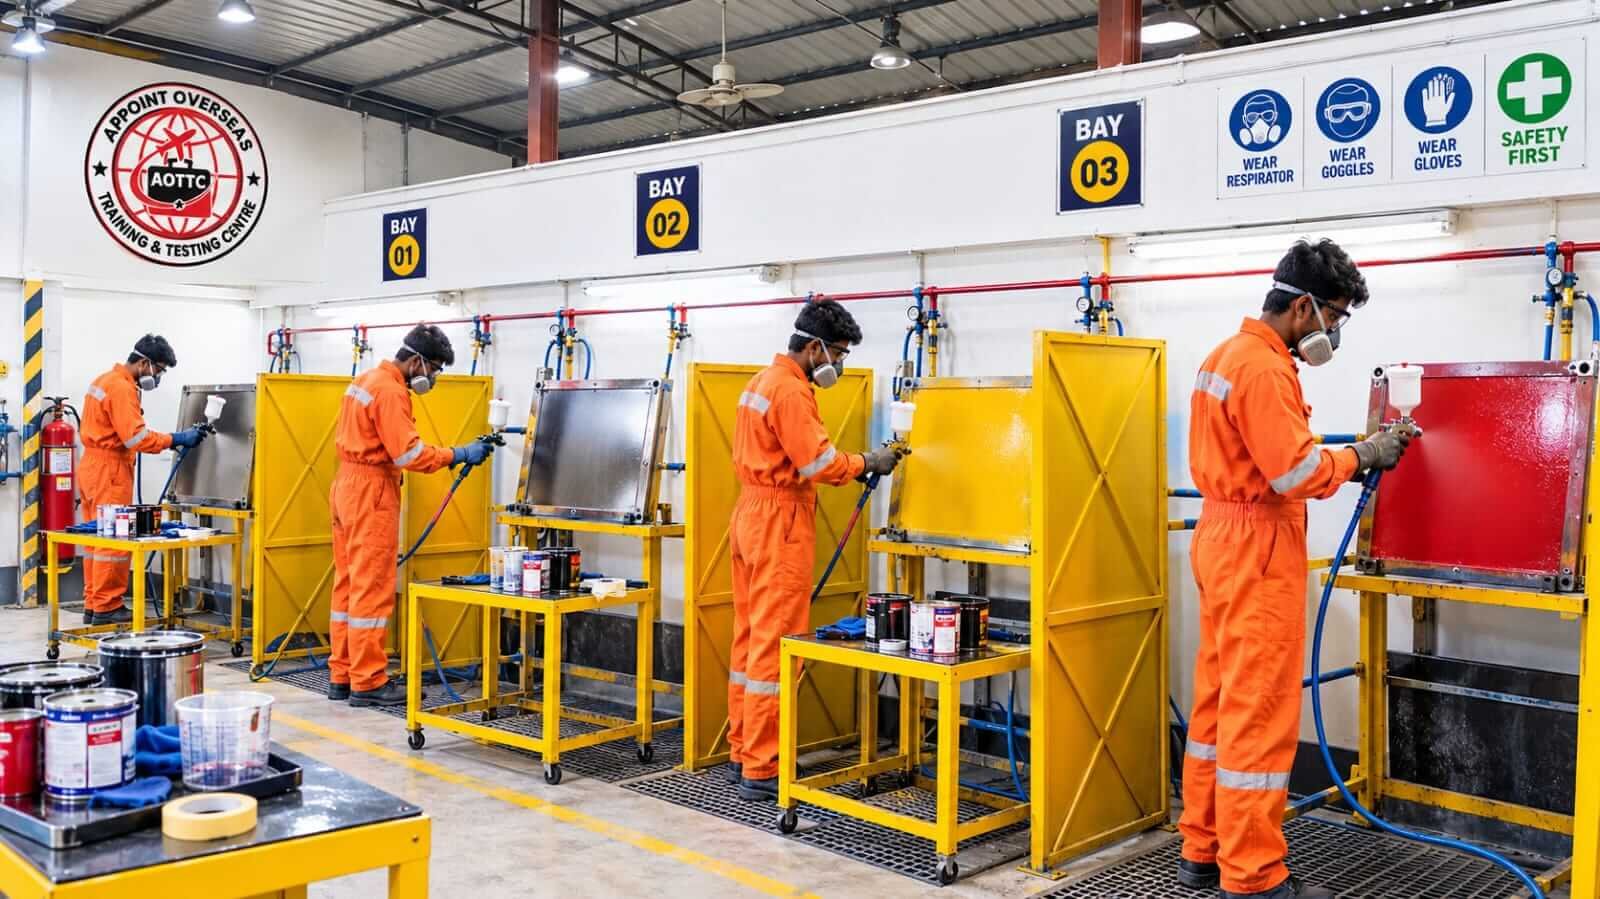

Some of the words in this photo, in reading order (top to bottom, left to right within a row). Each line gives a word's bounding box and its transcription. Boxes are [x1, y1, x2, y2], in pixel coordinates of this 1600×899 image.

[103, 90, 167, 144] APPOINT
[173, 91, 253, 152] OVERSEAS
[1076, 113, 1124, 141] BAY
[1418, 137, 1457, 155] WEAR
[1501, 125, 1569, 147] SAFETY
[1243, 155, 1277, 170] WEAR
[1329, 147, 1366, 163] WEAR
[1414, 154, 1462, 171] GLOVES
[1508, 145, 1560, 166] FIRST
[1080, 156, 1119, 188] 03
[1226, 169, 1294, 187] RESPIRATOR
[1321, 161, 1374, 179] GOGGLES
[151, 174, 206, 189] AOTTC
[649, 176, 686, 198] BAY
[98, 191, 148, 248] TRAINING
[150, 240, 161, 254] &
[166, 239, 220, 257] TESTING
[222, 199, 256, 243] CENTRE
[391, 216, 417, 235] BAY
[653, 212, 681, 237] 02
[394, 245, 412, 266] 01
